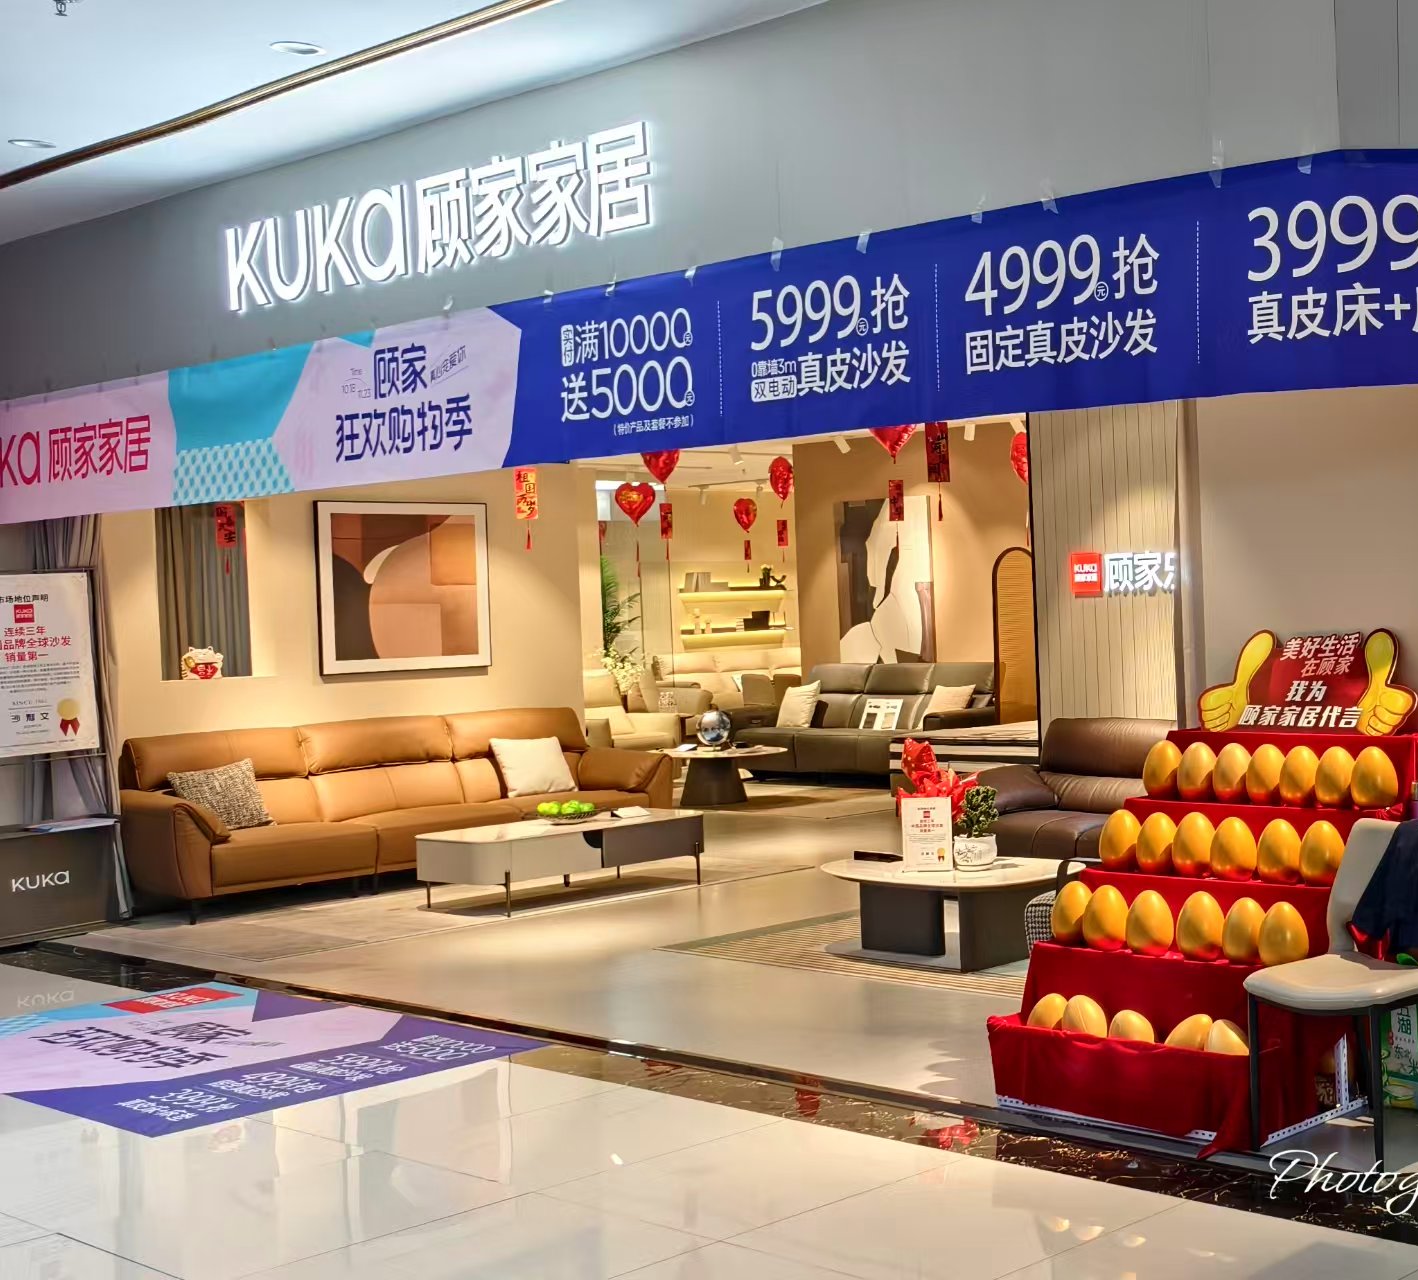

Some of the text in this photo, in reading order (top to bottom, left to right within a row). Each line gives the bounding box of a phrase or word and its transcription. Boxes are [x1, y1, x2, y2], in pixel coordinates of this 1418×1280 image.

[417, 121, 652, 273] 顾家家居
[965, 308, 1159, 375] 固定真皮沙发
[374, 343, 428, 399] 顾家
[797, 340, 911, 397] 真皮沙发
[753, 376, 796, 401] 双电动
[336, 393, 472, 462] 狂欢购物季
[48, 415, 151, 482] 顾家家居
[4, 626, 46, 638] 连续三年
[1280, 632, 1361, 661] 美好生活
[5, 651, 49, 663] 销量第一
[1301, 655, 1355, 678] 在顾家
[1285, 680, 1328, 702] 我为
[1238, 704, 1364, 729] 顾家家居代言
